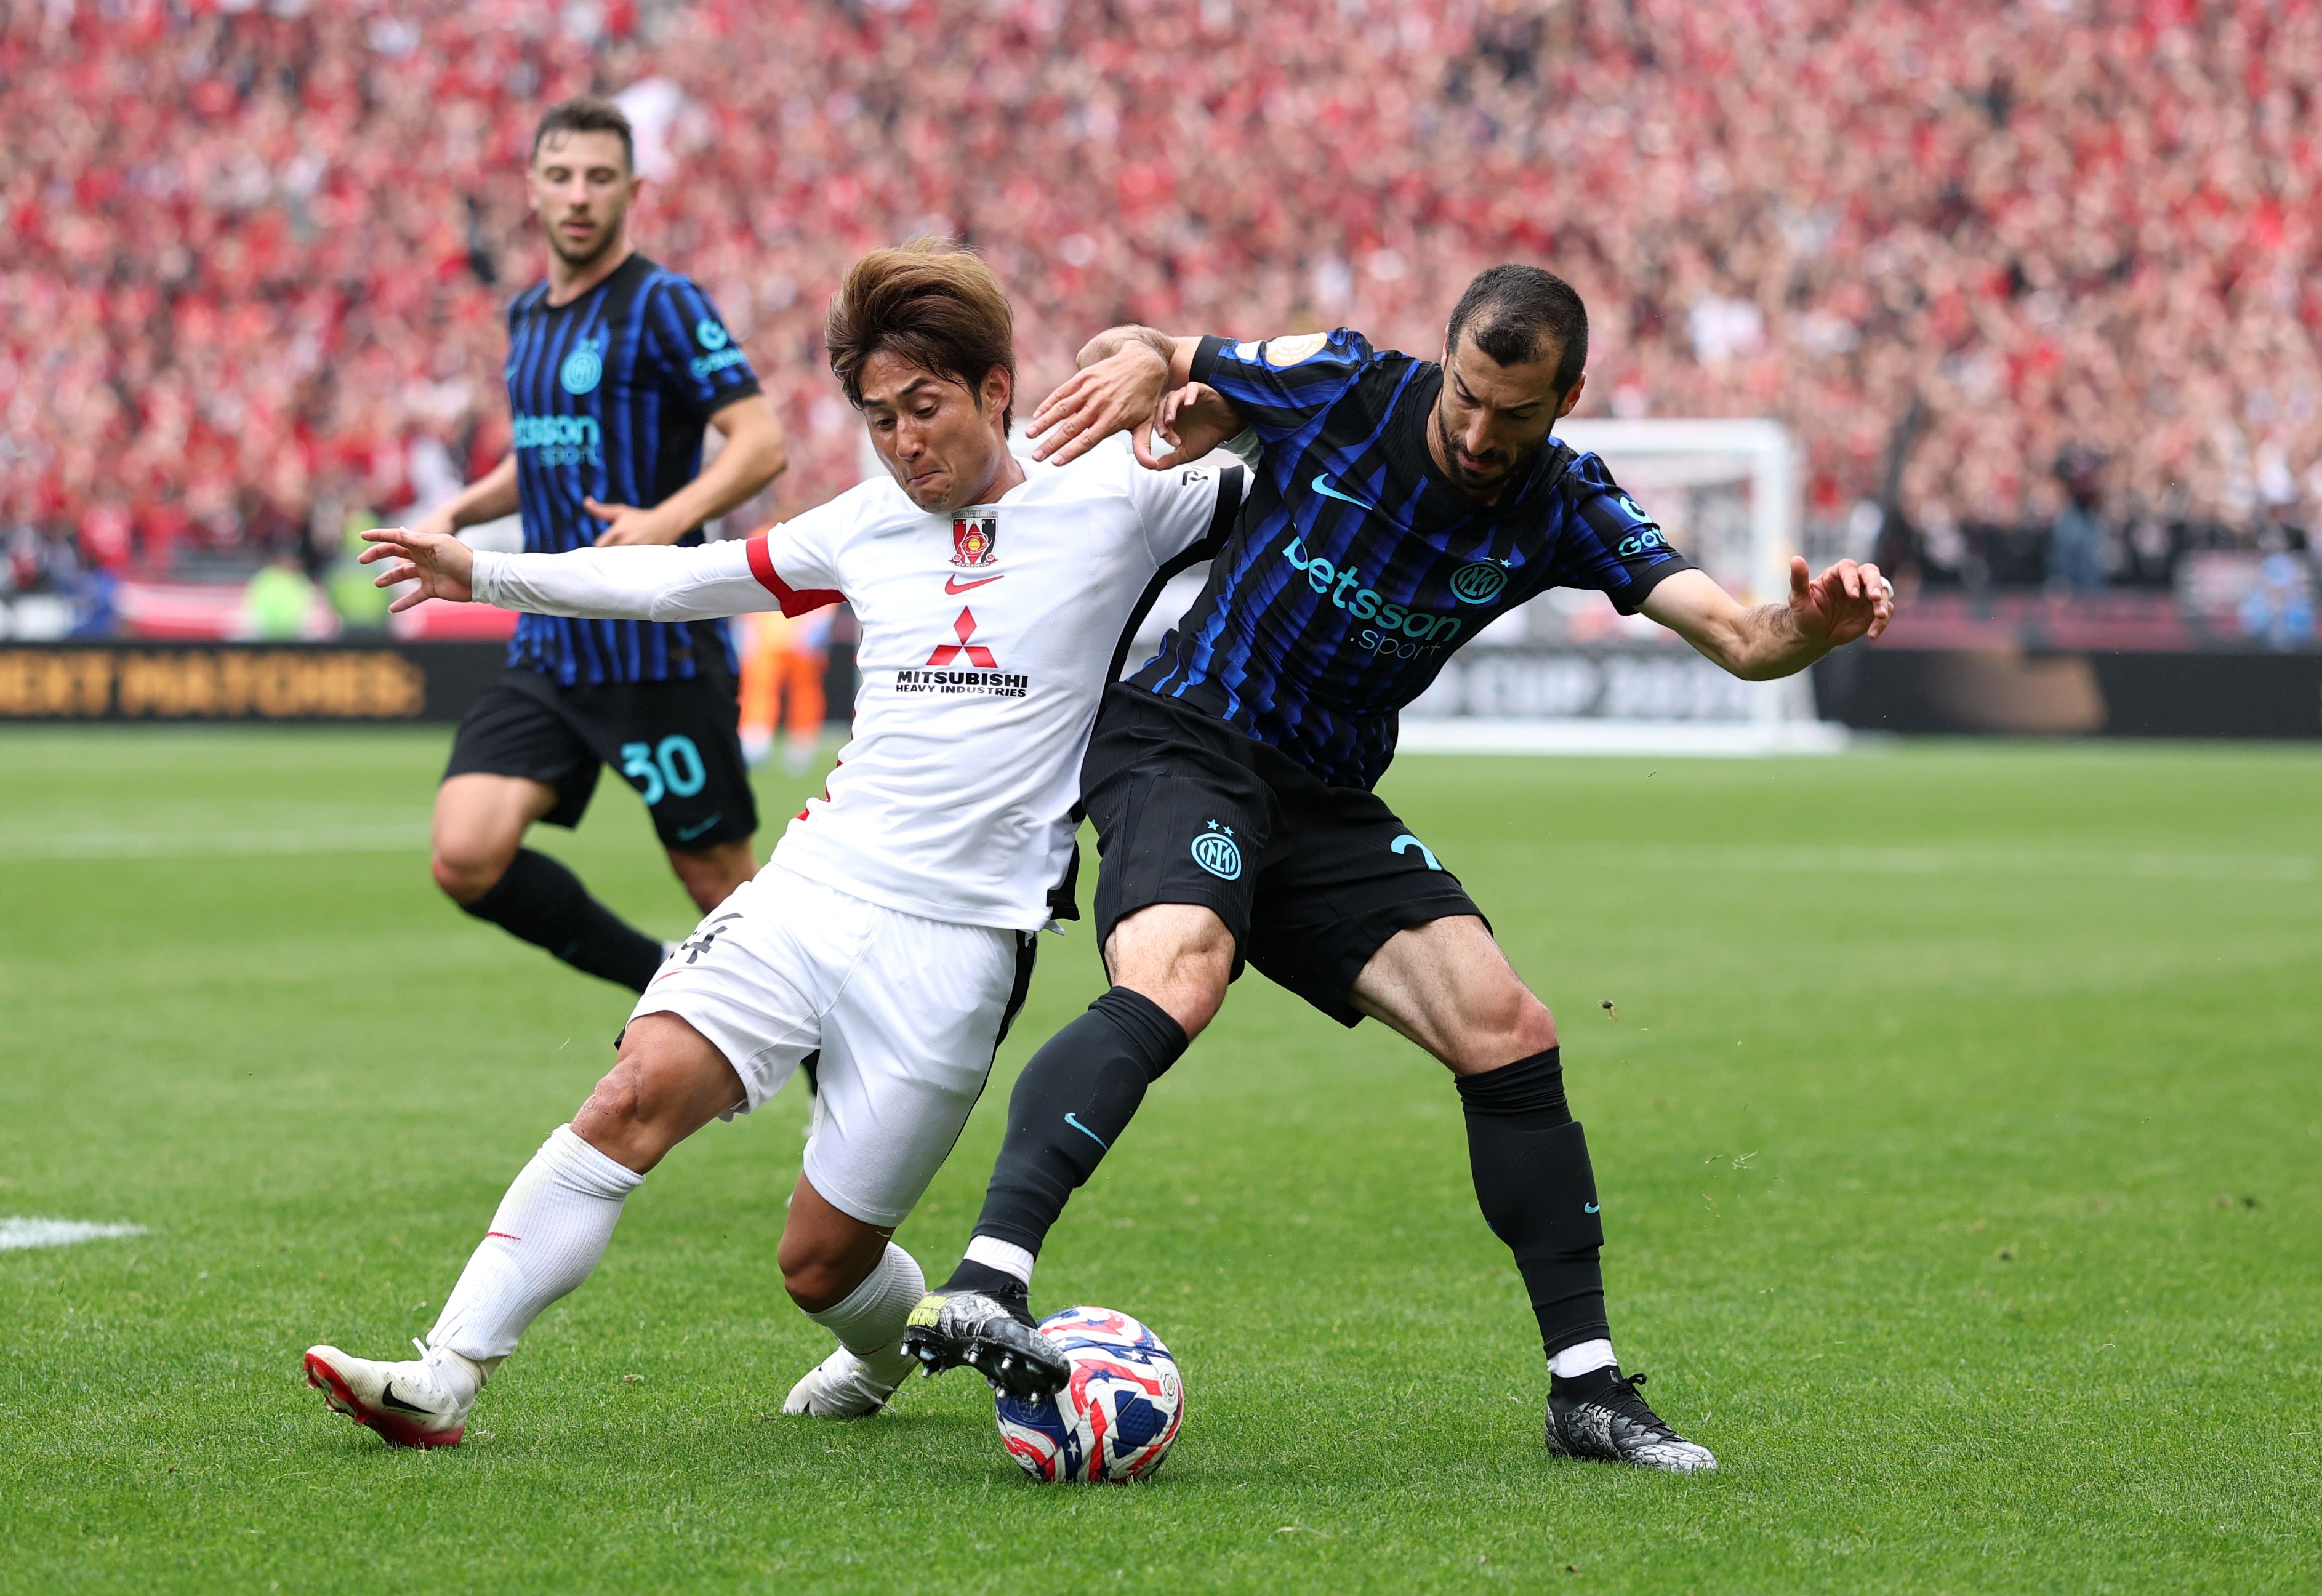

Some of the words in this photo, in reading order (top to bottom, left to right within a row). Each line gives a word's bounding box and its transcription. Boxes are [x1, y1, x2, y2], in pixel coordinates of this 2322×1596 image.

[1282, 522, 1461, 641] betsson
[896, 684, 936, 692] HEAVY
[941, 686, 1026, 697] INDUSTRIES
[897, 671, 1028, 688] MITSUBISHI
[621, 734, 707, 806] 30
